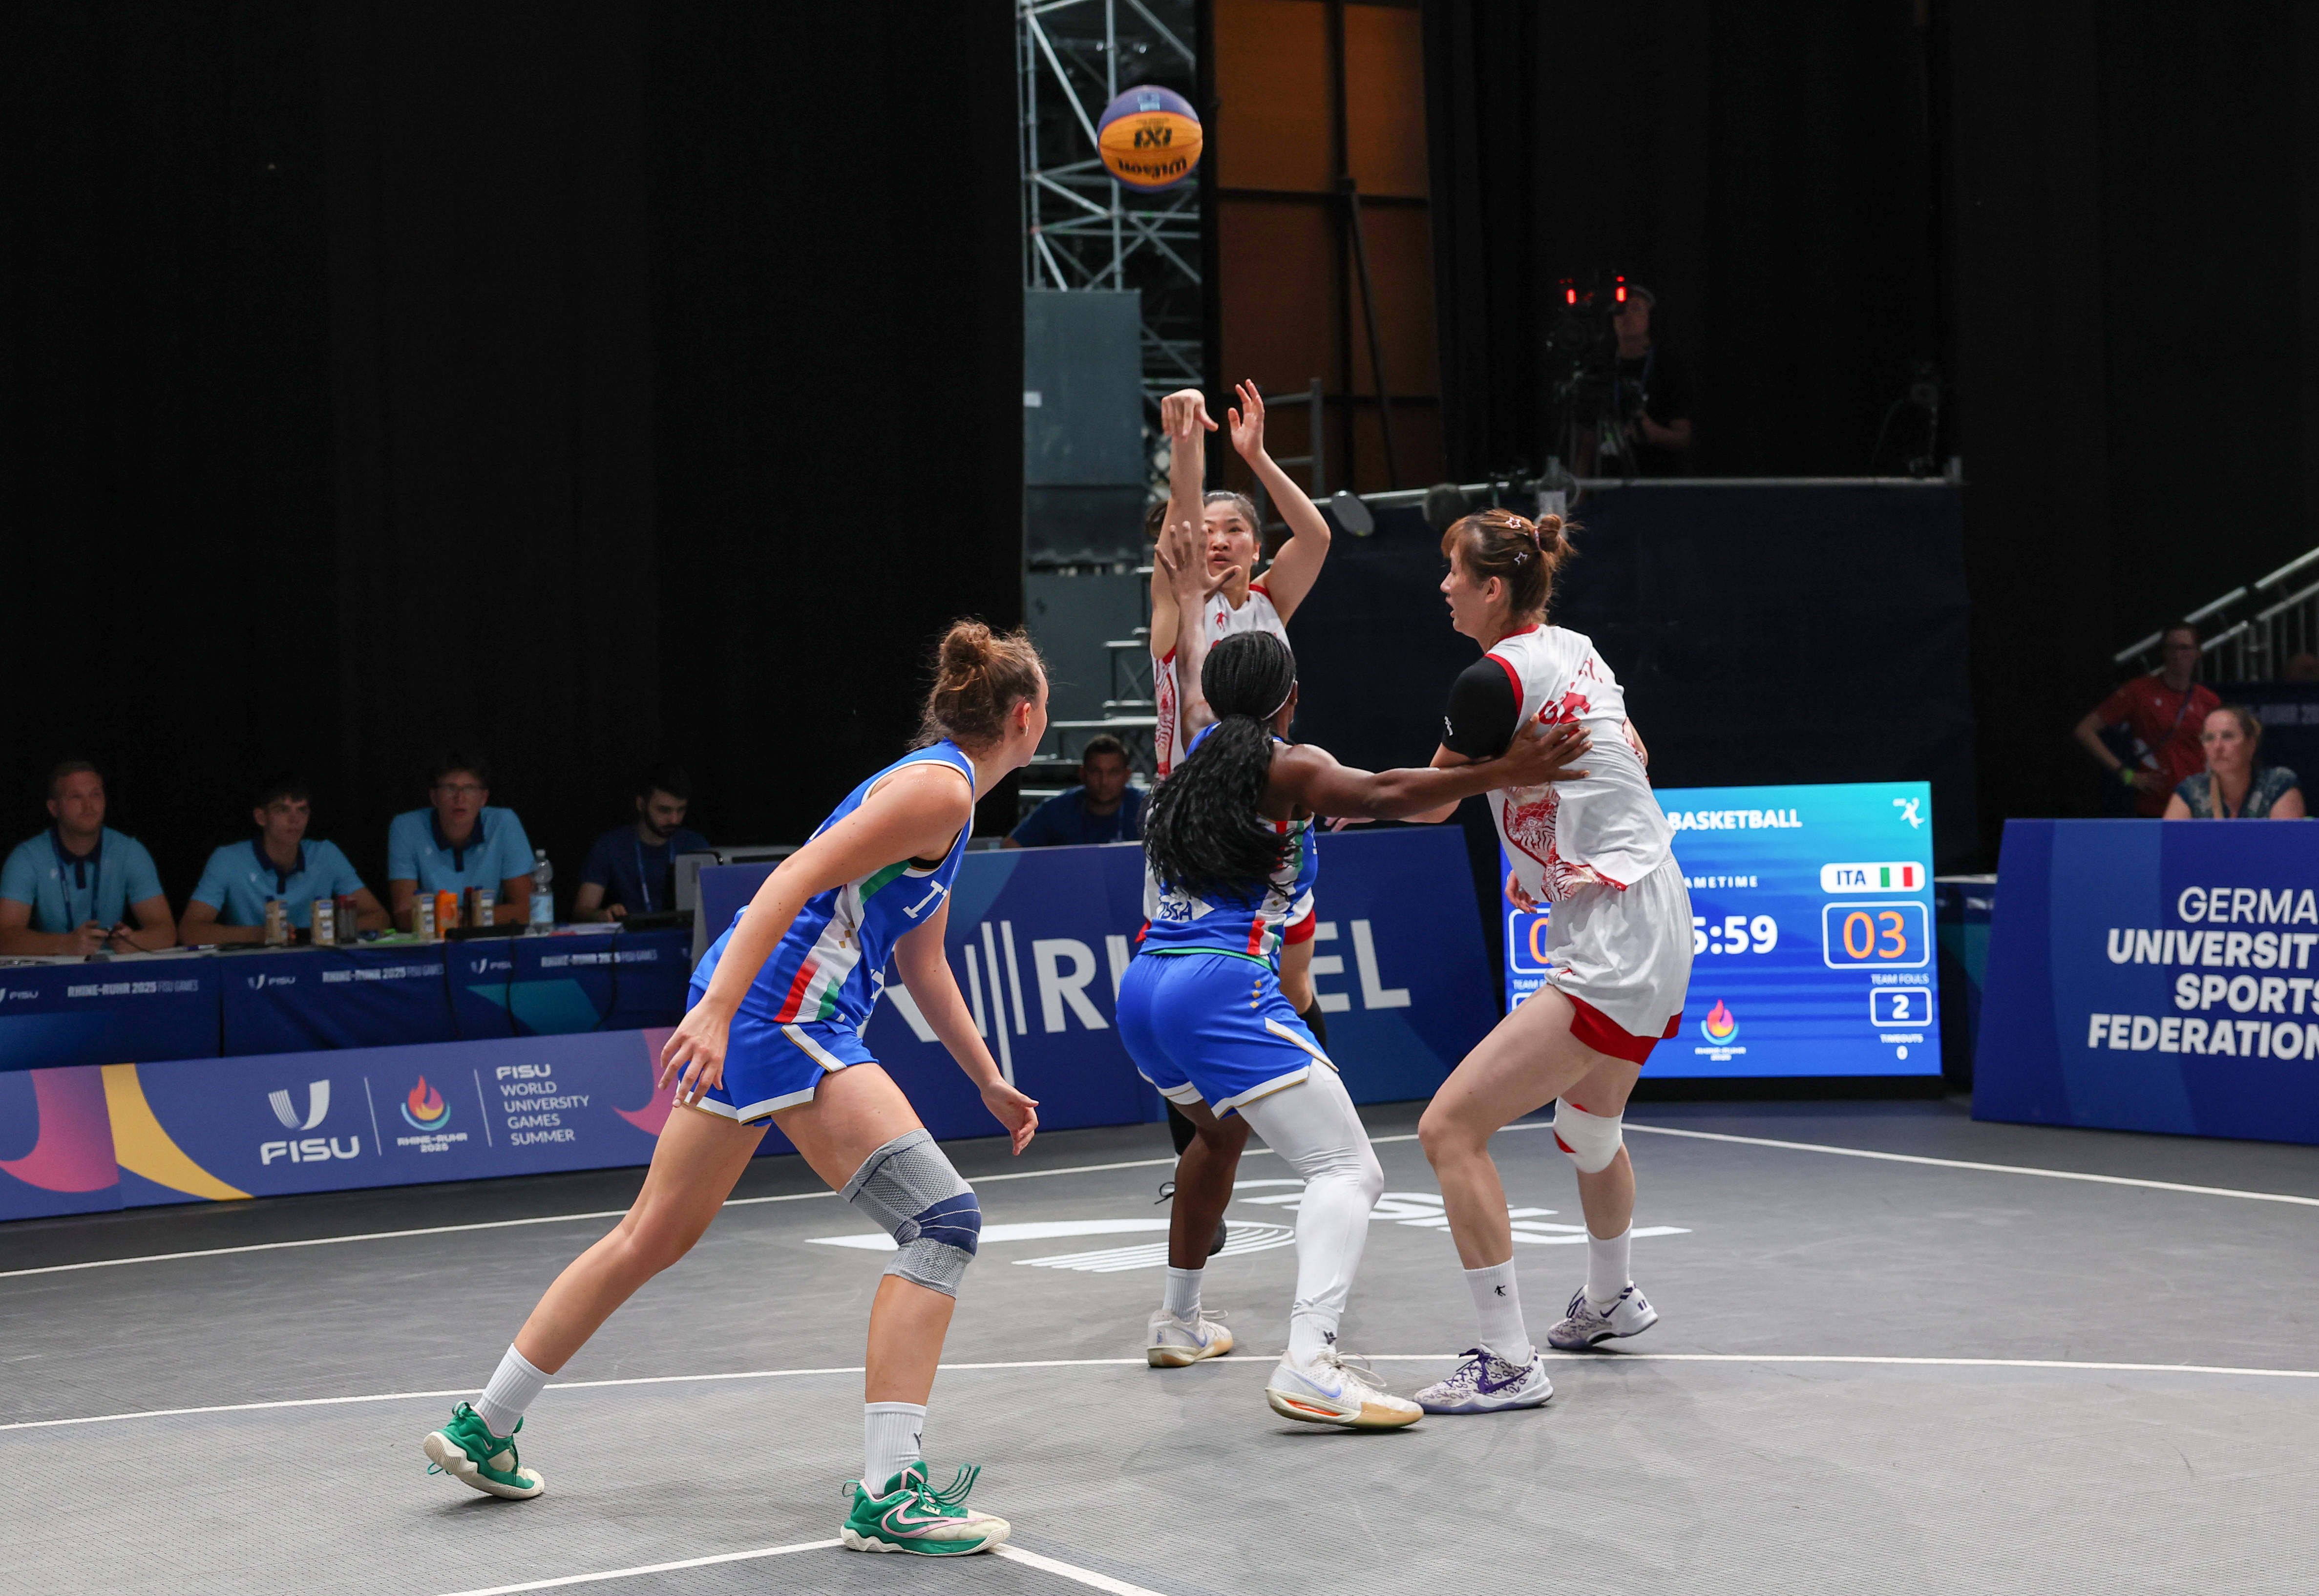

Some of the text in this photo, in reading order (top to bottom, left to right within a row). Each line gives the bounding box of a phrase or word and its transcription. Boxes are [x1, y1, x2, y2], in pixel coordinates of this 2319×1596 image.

[1666, 808, 1803, 831] BASKETBALL
[1684, 876, 1758, 888] AMETIME
[1836, 870, 1866, 885] ITA
[2178, 886, 2319, 925] GERMA
[1843, 911, 1907, 959] 03
[2107, 928, 2319, 969] UNIVERSIT
[1871, 973, 1930, 985] TEAM FOULS
[1892, 994, 1910, 1019] 2
[1880, 1033, 1924, 1044] TIMEOUTS
[1897, 1045, 1908, 1060] 0
[496, 1064, 551, 1080] FISU
[500, 1081, 557, 1097] WORLD
[504, 1095, 590, 1113] UNIVERSITY
[507, 1113, 561, 1130] GAMES
[397, 1132, 468, 1147] RHINE-RUHR
[510, 1129, 576, 1146] SUMMER
[260, 1135, 360, 1166] FISU
